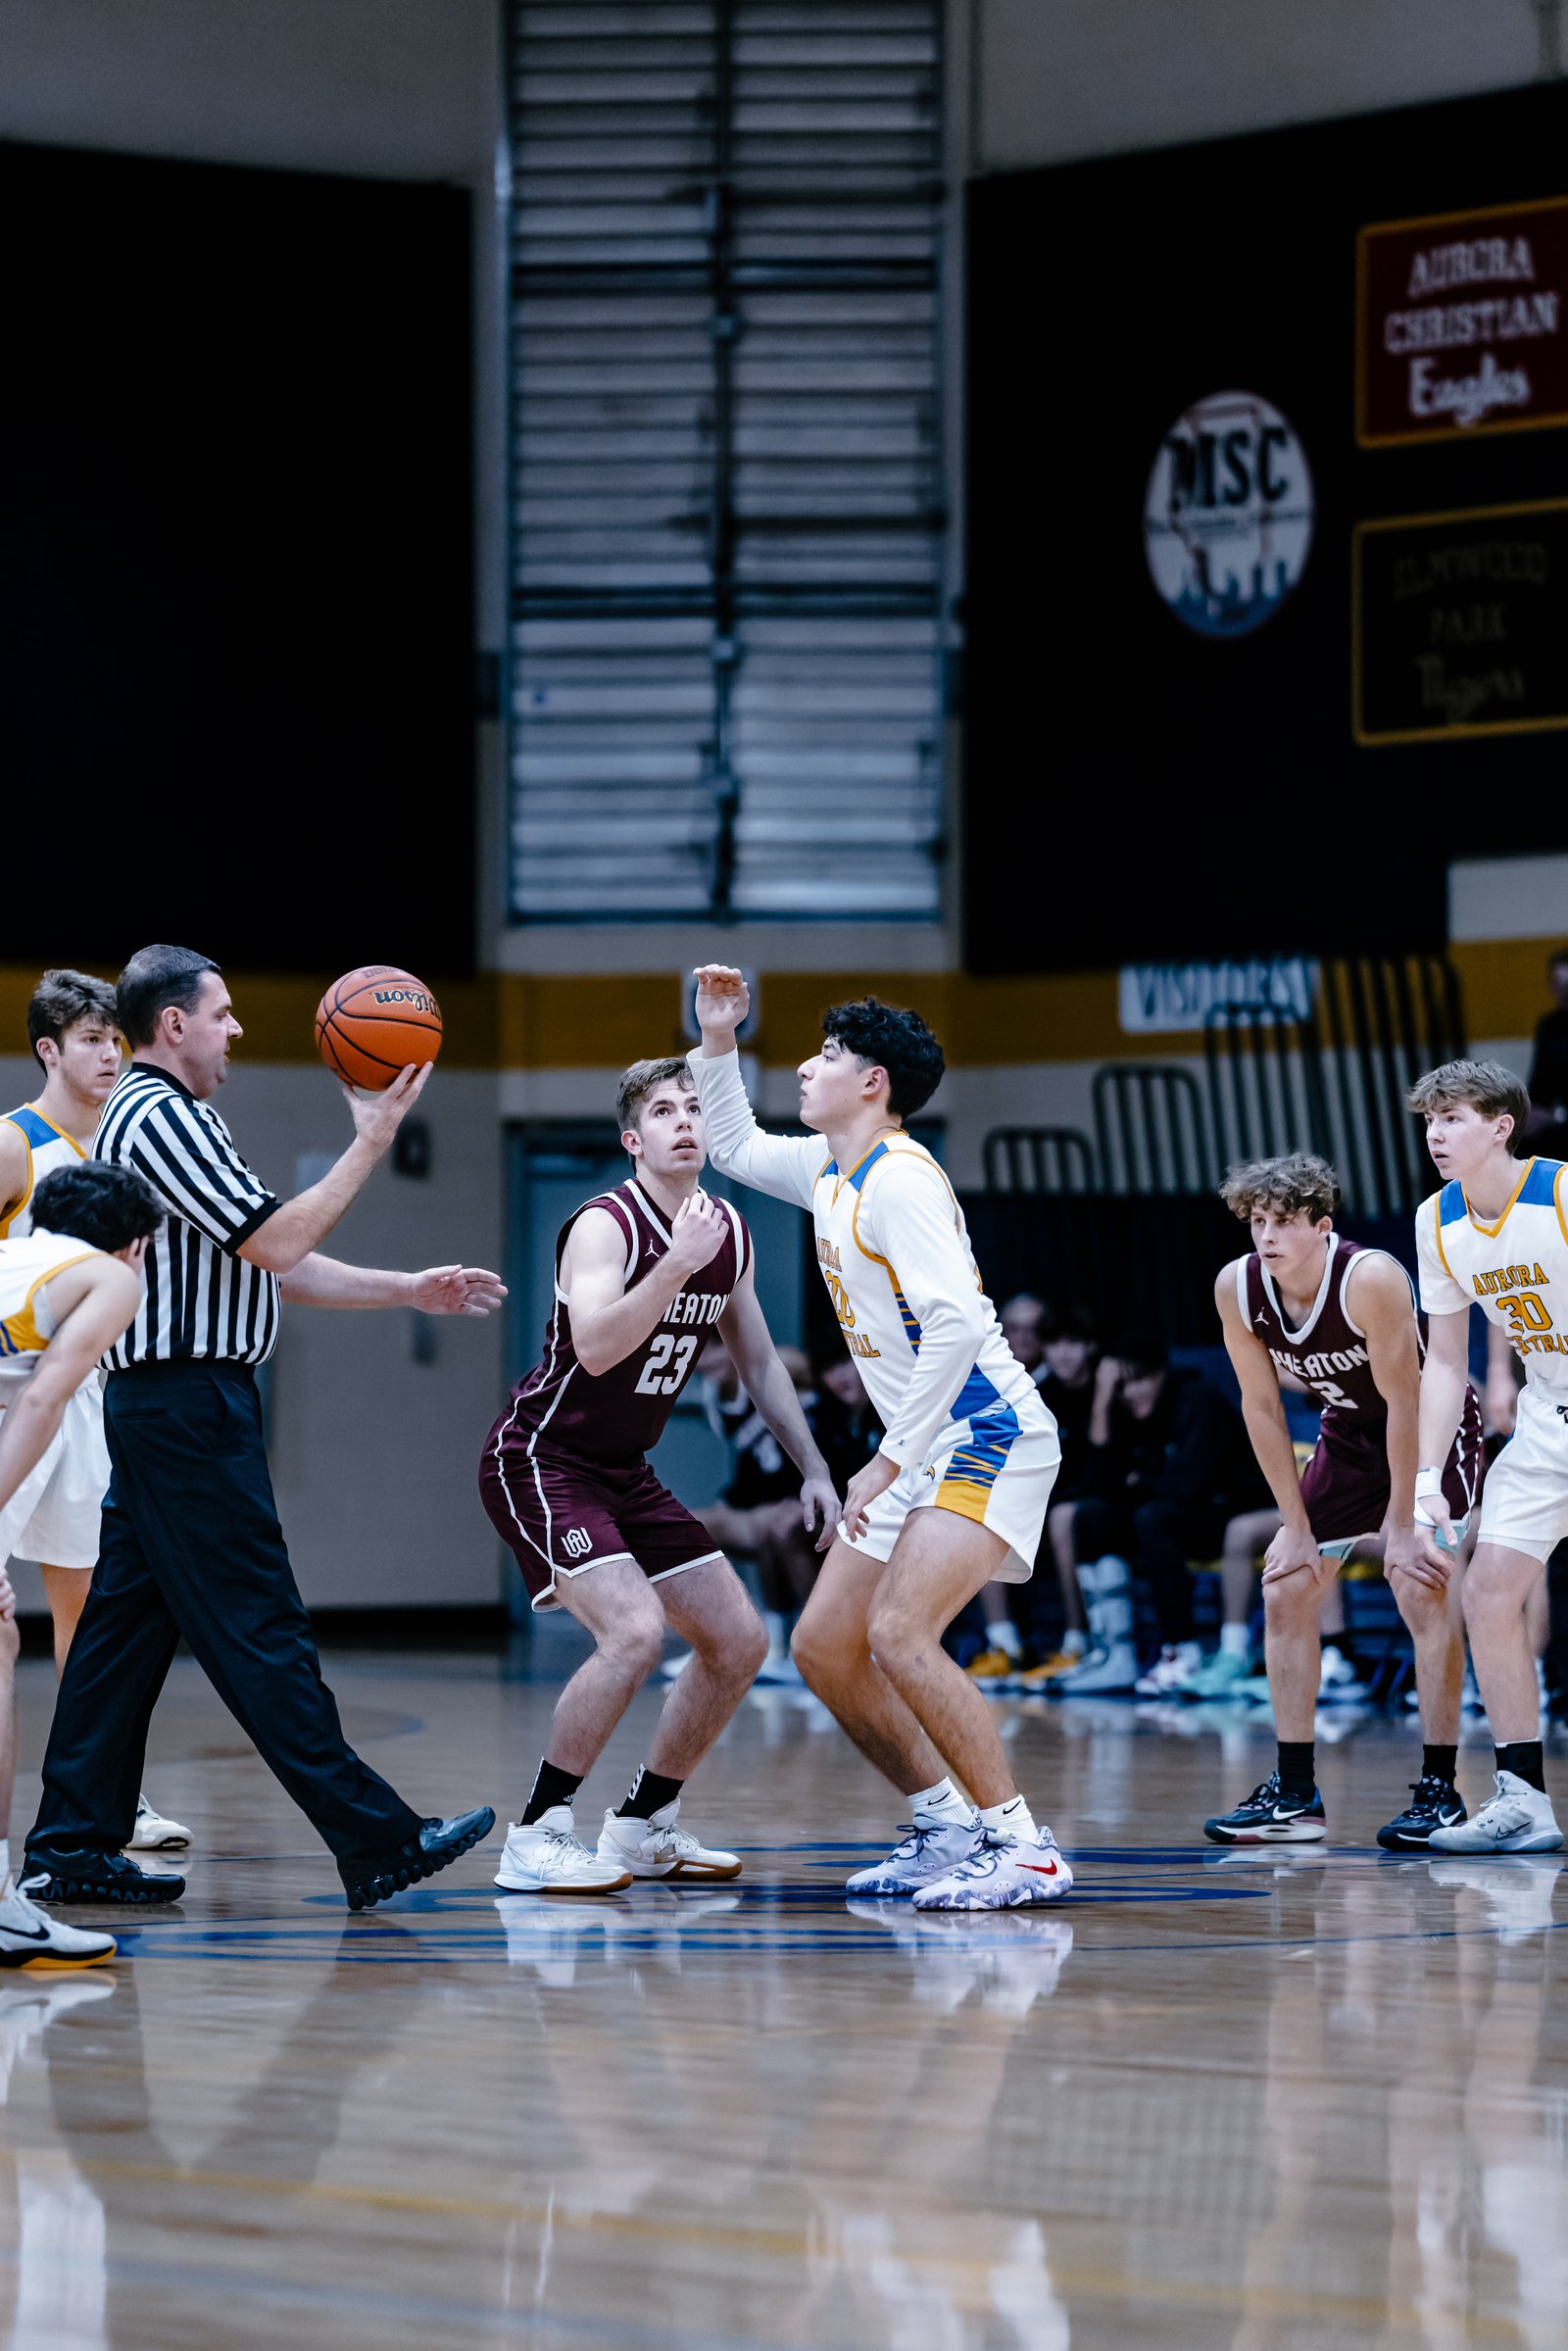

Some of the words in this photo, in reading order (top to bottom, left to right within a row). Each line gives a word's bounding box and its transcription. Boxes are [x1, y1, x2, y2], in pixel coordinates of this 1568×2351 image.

[1406, 234, 1537, 301] AURORA
[1383, 288, 1560, 357] CHRISTIAN
[1408, 349, 1533, 428] Eagles
[374, 990, 441, 1022] Wilson
[1472, 1262, 1549, 1296] AURORA
[1495, 1292, 1553, 1335] 30
[634, 1334, 698, 1396] 23
[1309, 1380, 1359, 1409] 2
